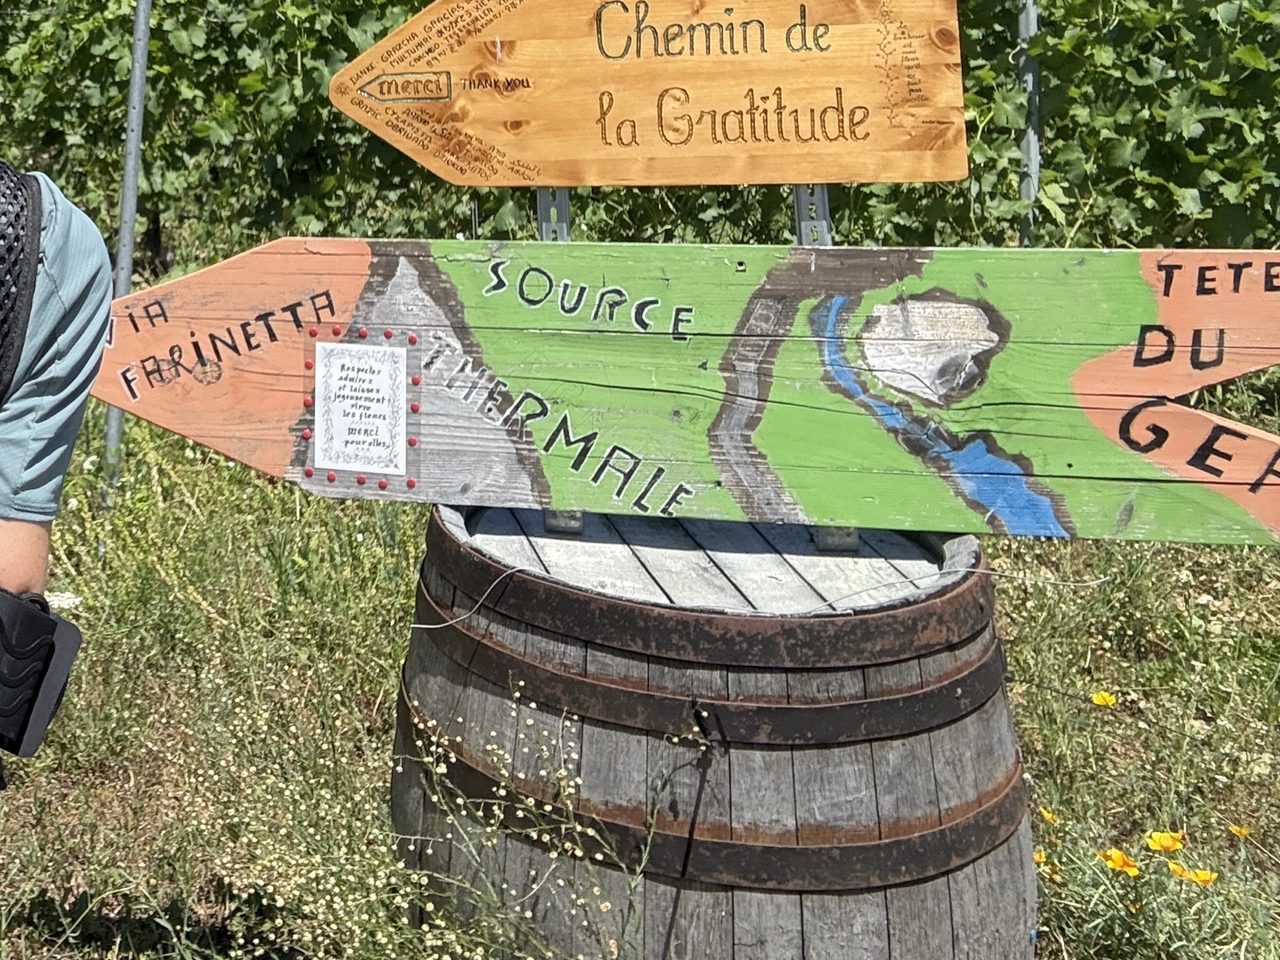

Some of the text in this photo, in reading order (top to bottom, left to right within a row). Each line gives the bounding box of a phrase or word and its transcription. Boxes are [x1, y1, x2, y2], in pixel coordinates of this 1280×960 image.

[595, 0, 768, 60] Chemin
[785, 3, 831, 54] de
[349, 63, 376, 85] DANKE
[377, 76, 443, 97] merci
[460, 77, 531, 91] THANK YOU
[385, 119, 429, 150] OBRIGADO
[595, 86, 871, 147] la Gratitude
[1157, 261, 1280, 298] TETE
[483, 259, 694, 341] SOURCE
[1133, 324, 1225, 371] DU
[421, 330, 695, 518] THERMALE
[342, 439, 367, 449] pour
